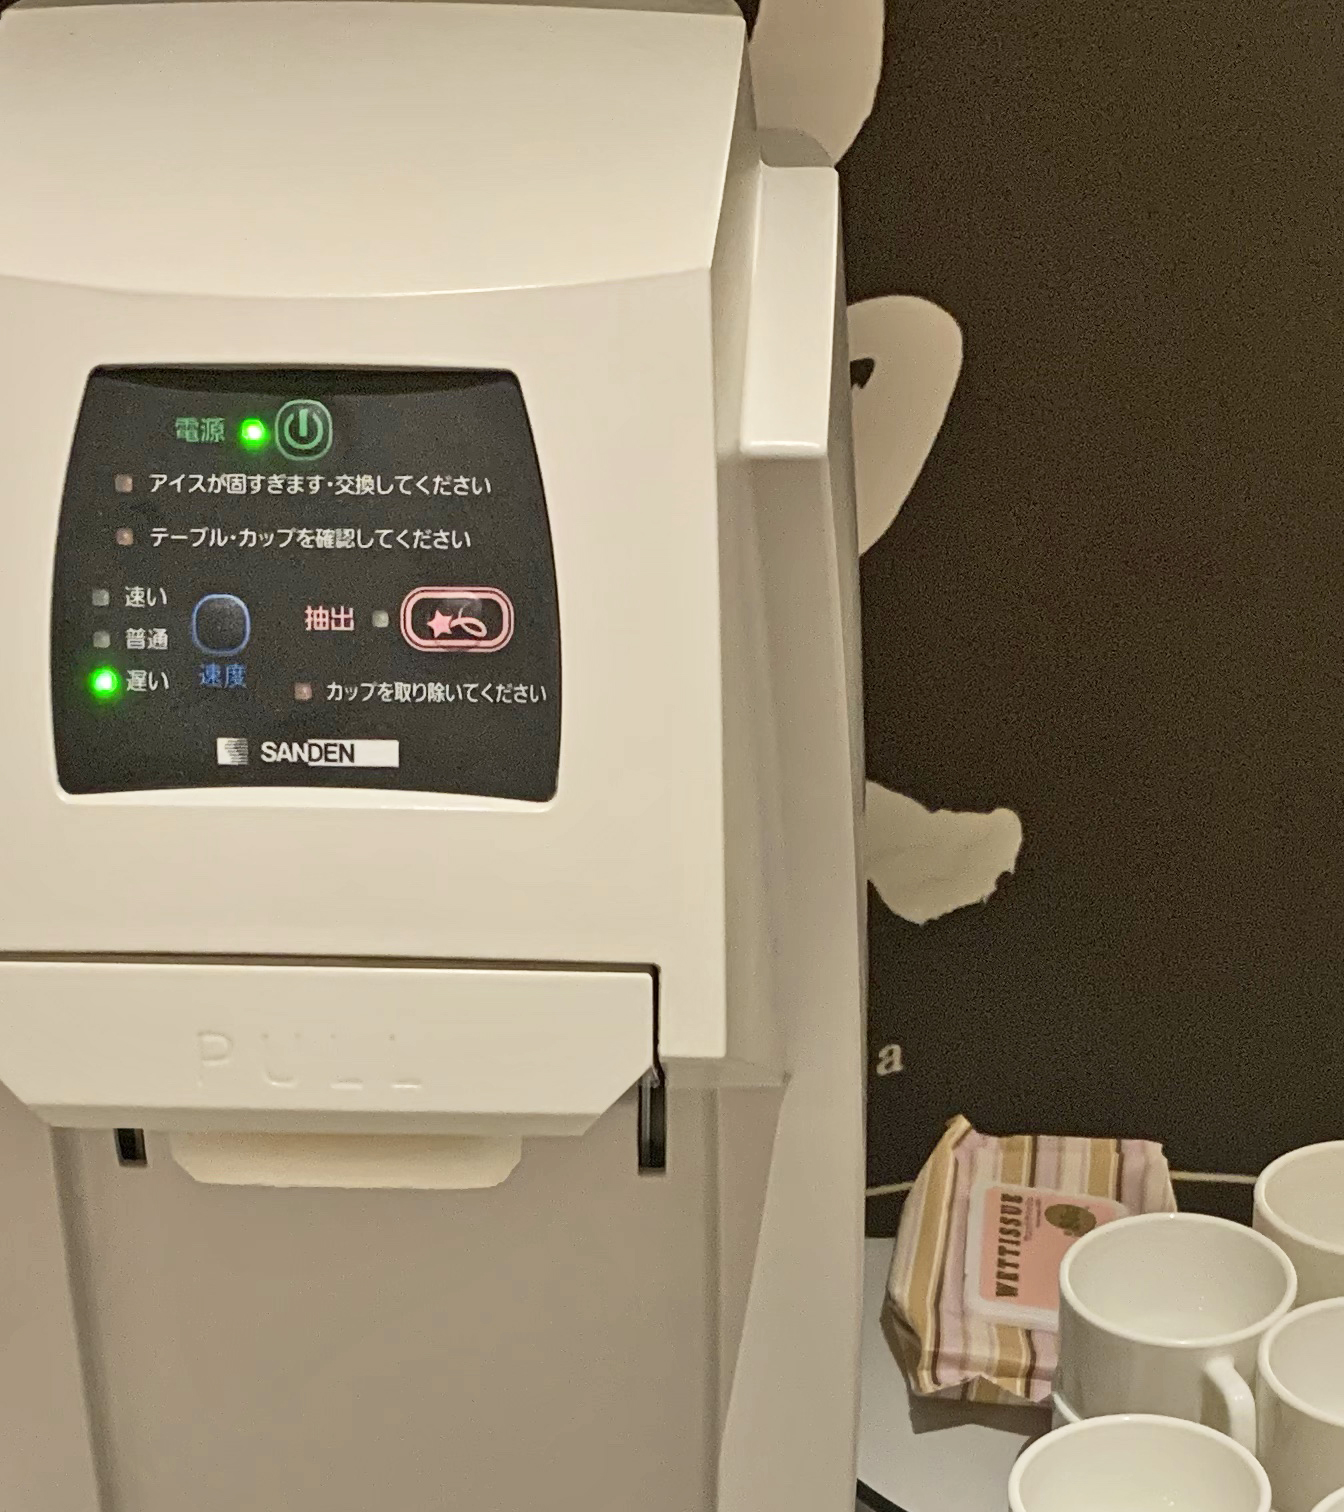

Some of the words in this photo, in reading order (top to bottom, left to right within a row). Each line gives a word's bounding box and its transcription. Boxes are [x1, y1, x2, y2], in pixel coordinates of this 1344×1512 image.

[175, 417, 225, 443] 電源
[125, 585, 168, 608] 速い
[305, 606, 354, 631] 抽出
[125, 629, 169, 651] 普通
[126, 669, 169, 692] 遅い
[199, 664, 247, 689] 速度
[326, 681, 547, 704] カップを取り除いてください
[260, 741, 355, 764] SANDEN
